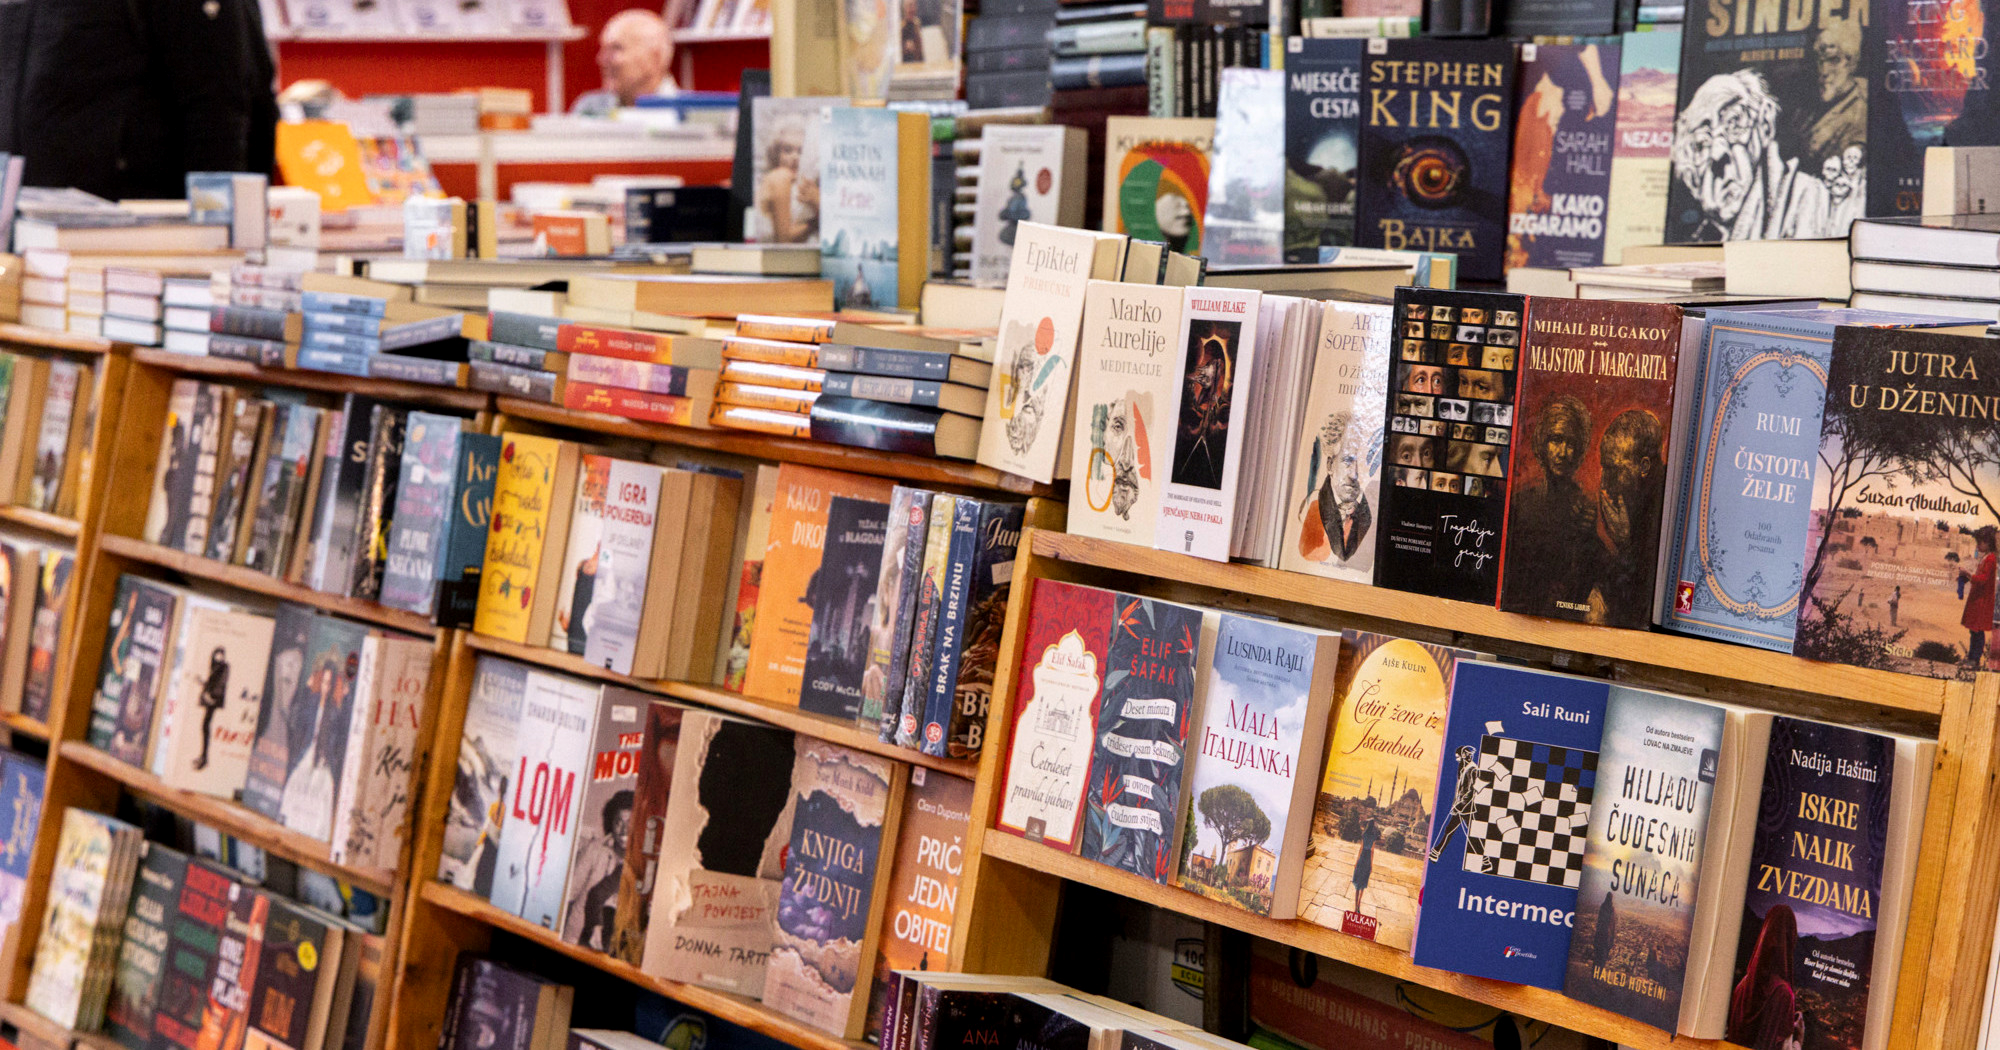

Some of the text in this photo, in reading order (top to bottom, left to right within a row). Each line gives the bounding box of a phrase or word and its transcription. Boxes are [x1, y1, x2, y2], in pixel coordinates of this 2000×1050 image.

[1369, 60, 1503, 87] STEPHEN
[1310, 98, 1360, 118] CESTA
[1369, 88, 1502, 131] KING
[1556, 131, 1609, 154] SARAH
[1566, 154, 1606, 176] HALL
[1552, 193, 1605, 216] KAKO
[1378, 218, 1476, 252] BAJKA
[1510, 212, 1602, 240] IZGARAMO
[1027, 242, 1079, 274] Epiktet
[1109, 297, 1162, 323] Marko
[1191, 300, 1246, 314] WILLIAM BLAKE
[1100, 325, 1166, 357] Aurelije
[1534, 320, 1670, 341] MIHAIL BULGAKOV
[1099, 359, 1162, 377] MEDITACIJE
[1529, 345, 1667, 381] MAJSTOR I MARGARITA
[1886, 350, 1979, 381] JUTRA
[1849, 382, 2000, 421] U DŽENINU
[1756, 412, 1801, 436] RUMI
[1734, 445, 1810, 480] ČISTOTA
[619, 482, 647, 505] IGRA
[785, 484, 820, 513] KAKO
[1741, 472, 1796, 504] ŽELJE
[1856, 484, 1979, 516] Suzan Abulhava
[607, 504, 652, 527] POVJERENJA
[1163, 506, 1188, 520] VJENČANJE
[1190, 511, 1203, 521] NEBA
[1207, 514, 1222, 524] PAKLA
[1758, 522, 1772, 531] 100
[986, 517, 1019, 550] Jan
[1441, 515, 1495, 547] Tragedija
[1744, 530, 1782, 544] Odabranih
[1454, 549, 1493, 570] genija
[1748, 543, 1775, 555] pesama
[1574, 602, 1591, 612] LIBRIS
[936, 562, 964, 694] BRAK NA BRZINU
[912, 609, 929, 677] OPASNA
[1141, 637, 1172, 659] ELIF
[1227, 636, 1304, 672] LUSINDA RAJLI
[1130, 654, 1176, 685] ŠAFAK
[1382, 657, 1427, 673] AJŠE KULIN
[811, 678, 835, 693] CODY
[1125, 701, 1145, 715] Deset
[1146, 702, 1170, 715] minuta
[1354, 679, 1440, 729] Četiri žene iz
[1522, 702, 1590, 724] Sali Runi
[1225, 699, 1279, 740] MALA
[1646, 726, 1654, 734] Od
[1654, 728, 1670, 738] autora
[618, 732, 643, 747] THE
[1107, 737, 1132, 754] trideset
[1133, 746, 1151, 757] osam
[1202, 726, 1290, 778] ITALIJANKA
[1341, 718, 1424, 760] Istanbula
[1644, 739, 1694, 756] LOVAC NA ZMAJEVE
[1790, 749, 1878, 783] Nadija Hašimi
[512, 756, 575, 840] LOM
[1132, 780, 1151, 794] ovom
[1623, 765, 1698, 813] HILJADU
[917, 798, 936, 813] Clara
[1798, 792, 1860, 831] ISKRE
[1607, 803, 1697, 863] ČUDESNIH
[801, 827, 863, 874] KNJIGA
[1791, 831, 1856, 871] NALIK
[694, 883, 741, 898] TAJNA
[792, 863, 861, 919] ŽUDNJI
[1611, 858, 1680, 907] SUNACA
[1757, 864, 1872, 918] ZVEZDAMA
[703, 903, 765, 920] POVIJEST
[1345, 911, 1375, 928] VULKAN
[675, 935, 722, 958] DONNA
[1593, 965, 1667, 1001] HALED HOSEINI
[1330, 999, 1388, 1041] BANANAS
[962, 1029, 999, 1045] ANA
